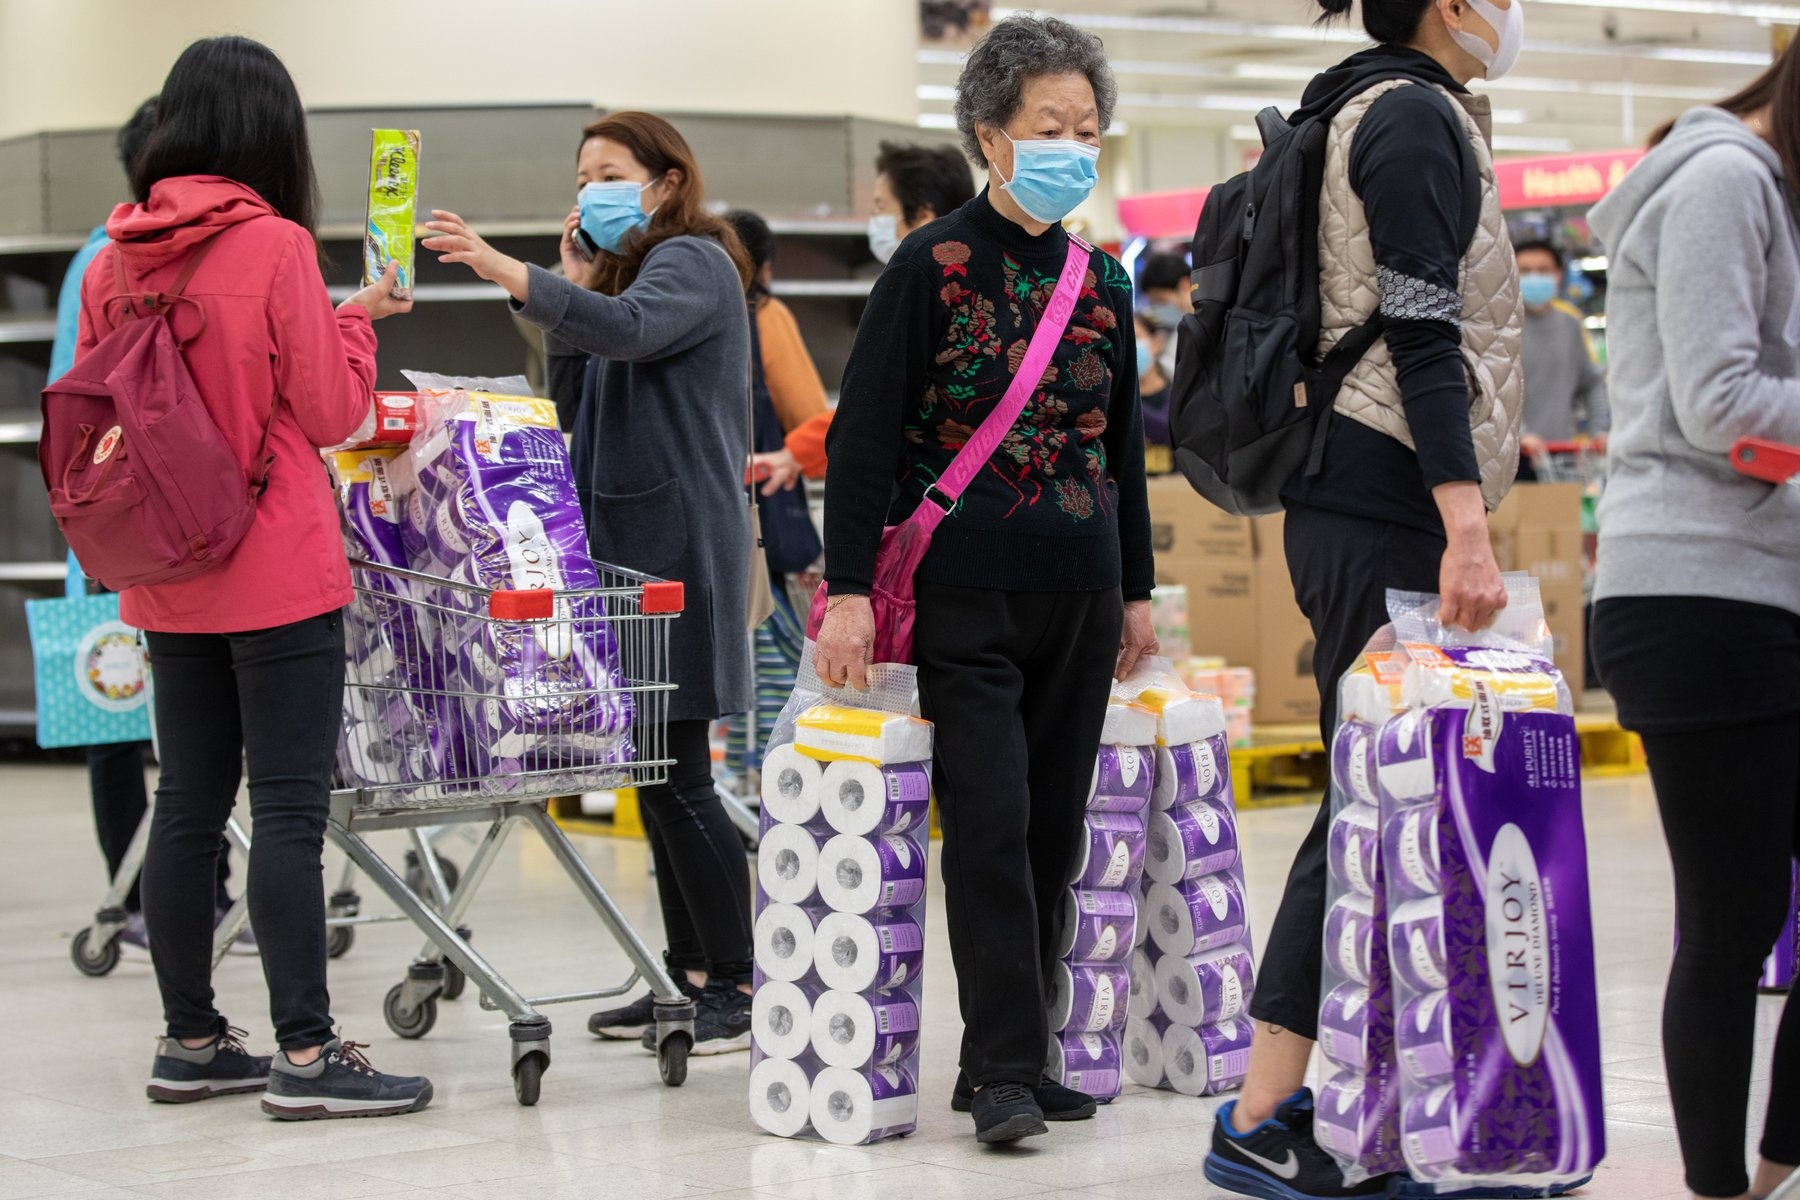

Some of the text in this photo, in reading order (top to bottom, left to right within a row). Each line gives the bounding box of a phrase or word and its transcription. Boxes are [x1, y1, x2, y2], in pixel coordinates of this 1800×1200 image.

[1522, 163, 1603, 199] Health
[1464, 735, 1484, 757] 送
[1523, 730, 1535, 788] 4x PURITY
[1527, 881, 1546, 1006] DELUXE DIAMOND
[1549, 913, 1559, 941] Strong
[1500, 872, 1531, 1025] VIRJOY
[1550, 942, 1562, 984] Delicately
[1551, 995, 1561, 1015] Pure
